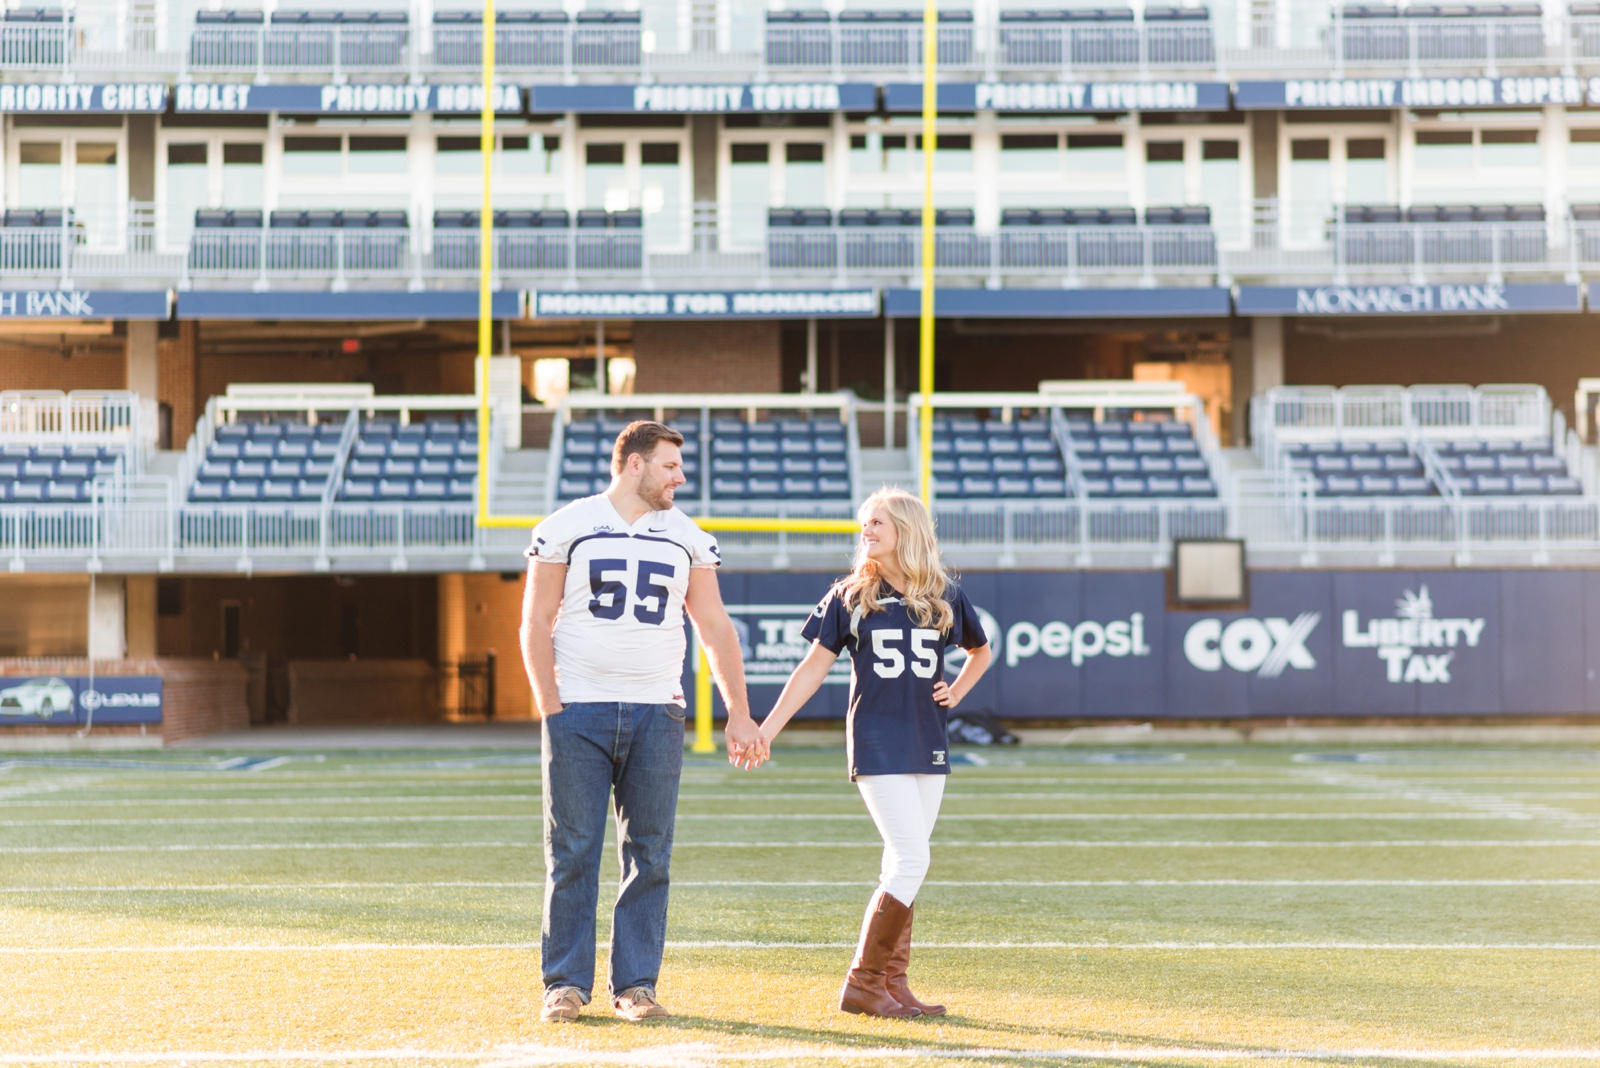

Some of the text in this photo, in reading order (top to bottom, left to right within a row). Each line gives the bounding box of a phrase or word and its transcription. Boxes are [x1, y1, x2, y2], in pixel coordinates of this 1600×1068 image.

[321, 84, 431, 111] PRIORITY
[634, 85, 840, 111] PRIORITY TOYOTA
[975, 83, 1197, 109] PRIORITY HYUNDAI
[1285, 77, 1579, 106] PRIORITY INDOOR SUPER
[26, 290, 94, 315] BANK
[538, 293, 667, 314] MONARCH
[673, 293, 729, 314] FOR
[1296, 285, 1509, 313] MONARCH BANK
[588, 558, 675, 626] 55
[1006, 611, 1146, 668] pepsi
[1342, 609, 1486, 648] LIBERTY
[871, 629, 941, 679] 55
[1377, 647, 1452, 683] TAX
[102, 692, 161, 707] LEXUS
